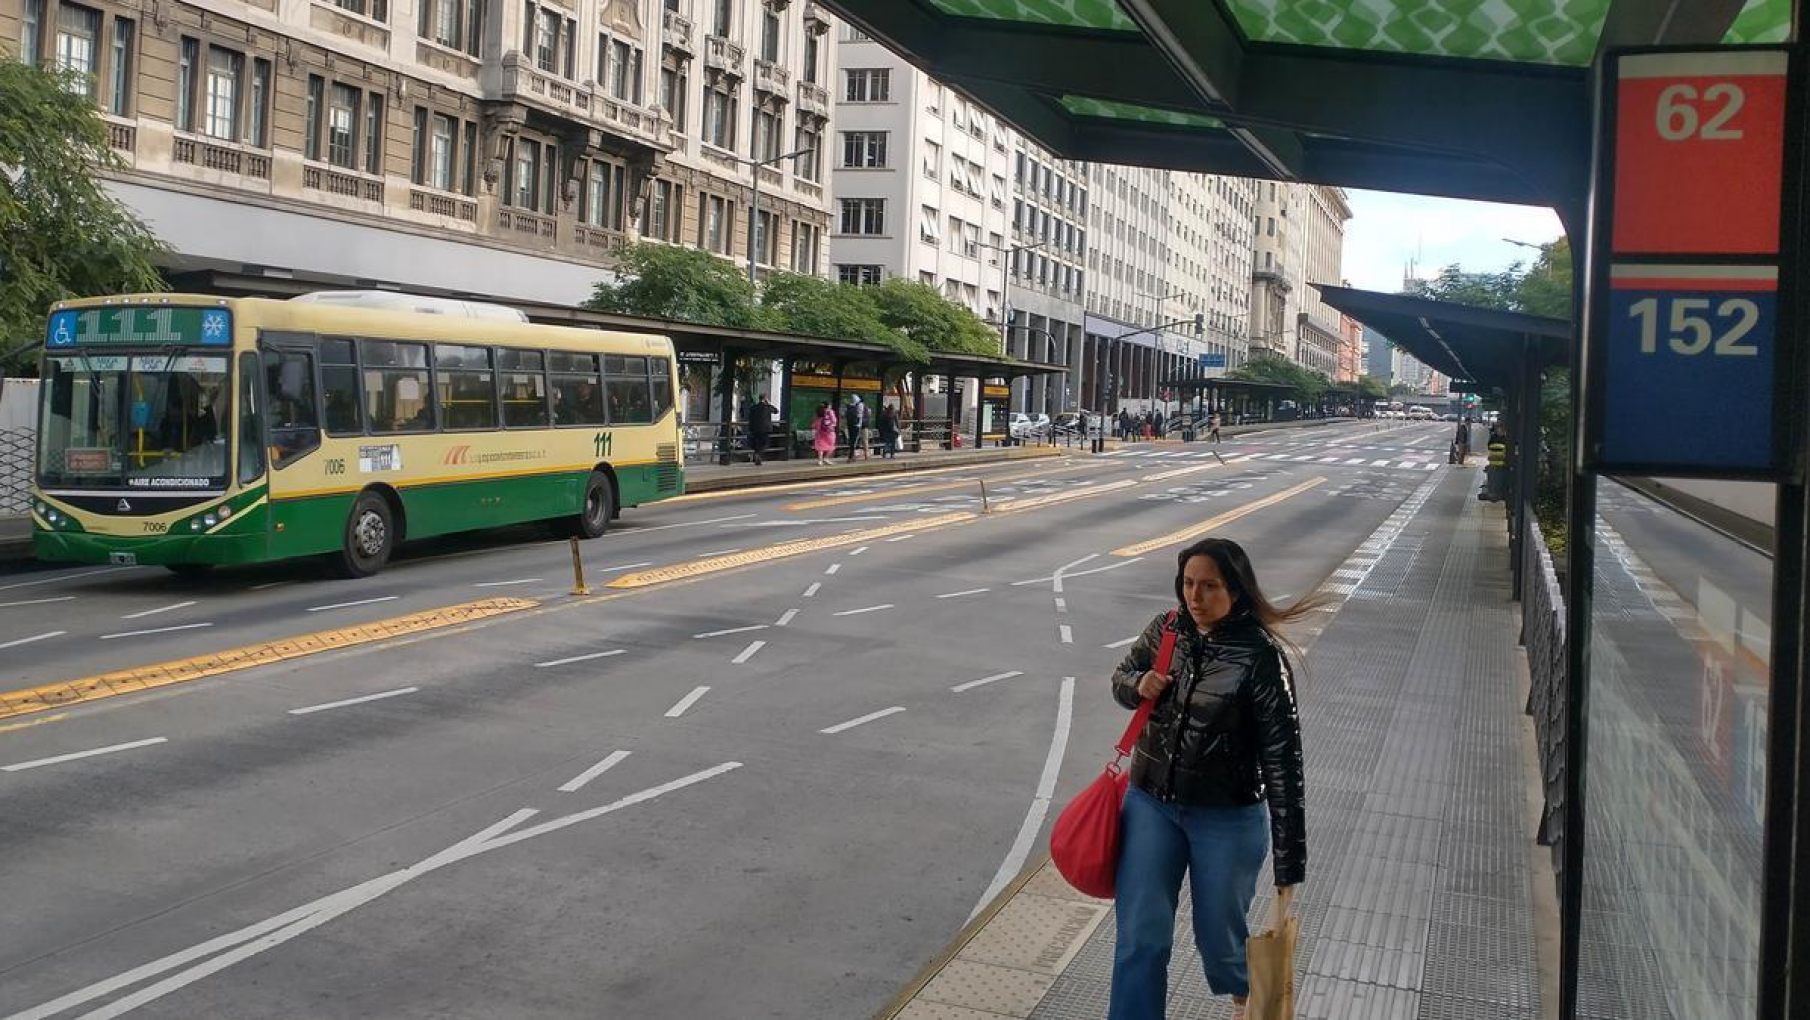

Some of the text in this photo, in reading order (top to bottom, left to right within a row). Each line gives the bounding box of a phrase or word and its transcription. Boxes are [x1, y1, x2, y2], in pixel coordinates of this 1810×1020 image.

[1654, 83, 1745, 141] 62
[75, 307, 181, 342] 111
[1628, 297, 1760, 356] 152
[593, 431, 612, 458] 111
[324, 458, 346, 475] 7006
[133, 478, 210, 486] AIRE ACONDICIONADO
[143, 521, 167, 532] 7006
